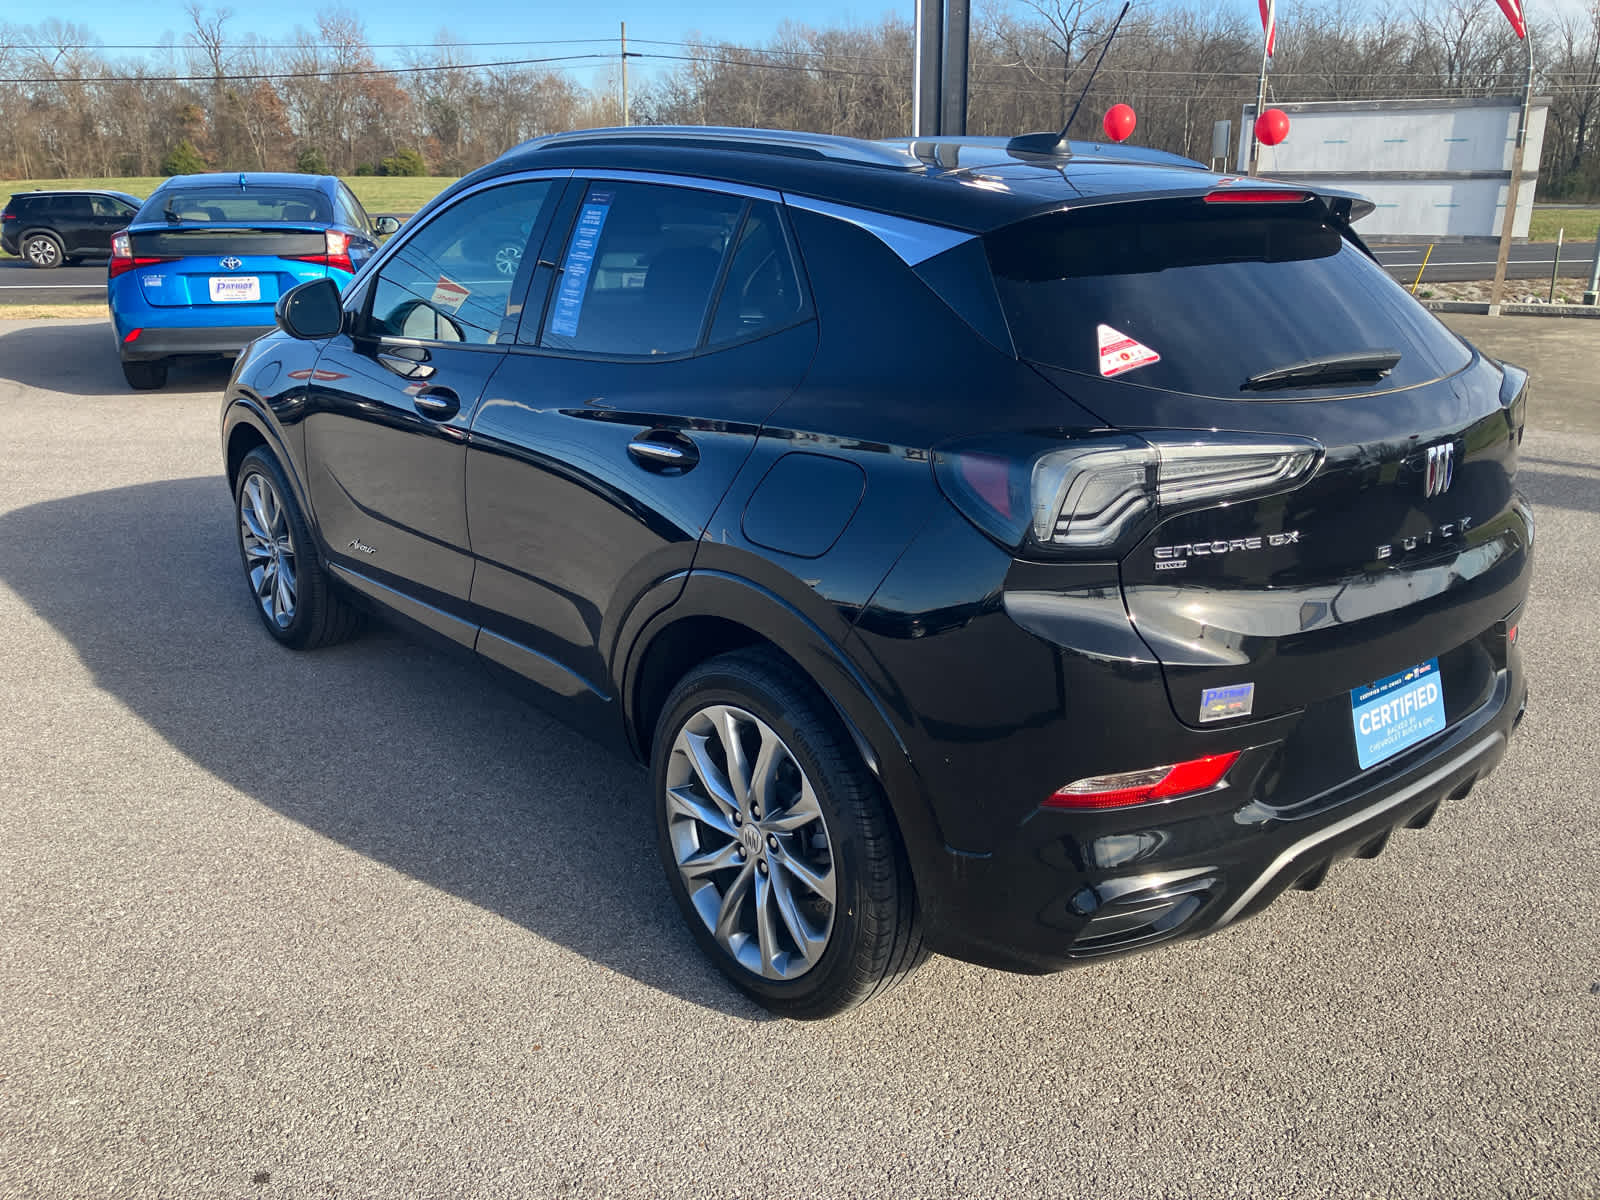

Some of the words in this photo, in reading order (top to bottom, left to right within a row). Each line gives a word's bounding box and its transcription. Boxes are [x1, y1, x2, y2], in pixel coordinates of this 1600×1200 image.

[1153, 536, 1262, 559] ENCORE
[1267, 530, 1300, 546] GX
[1376, 516, 1472, 560] BUICK
[1359, 683, 1438, 736] CERTIFIED
